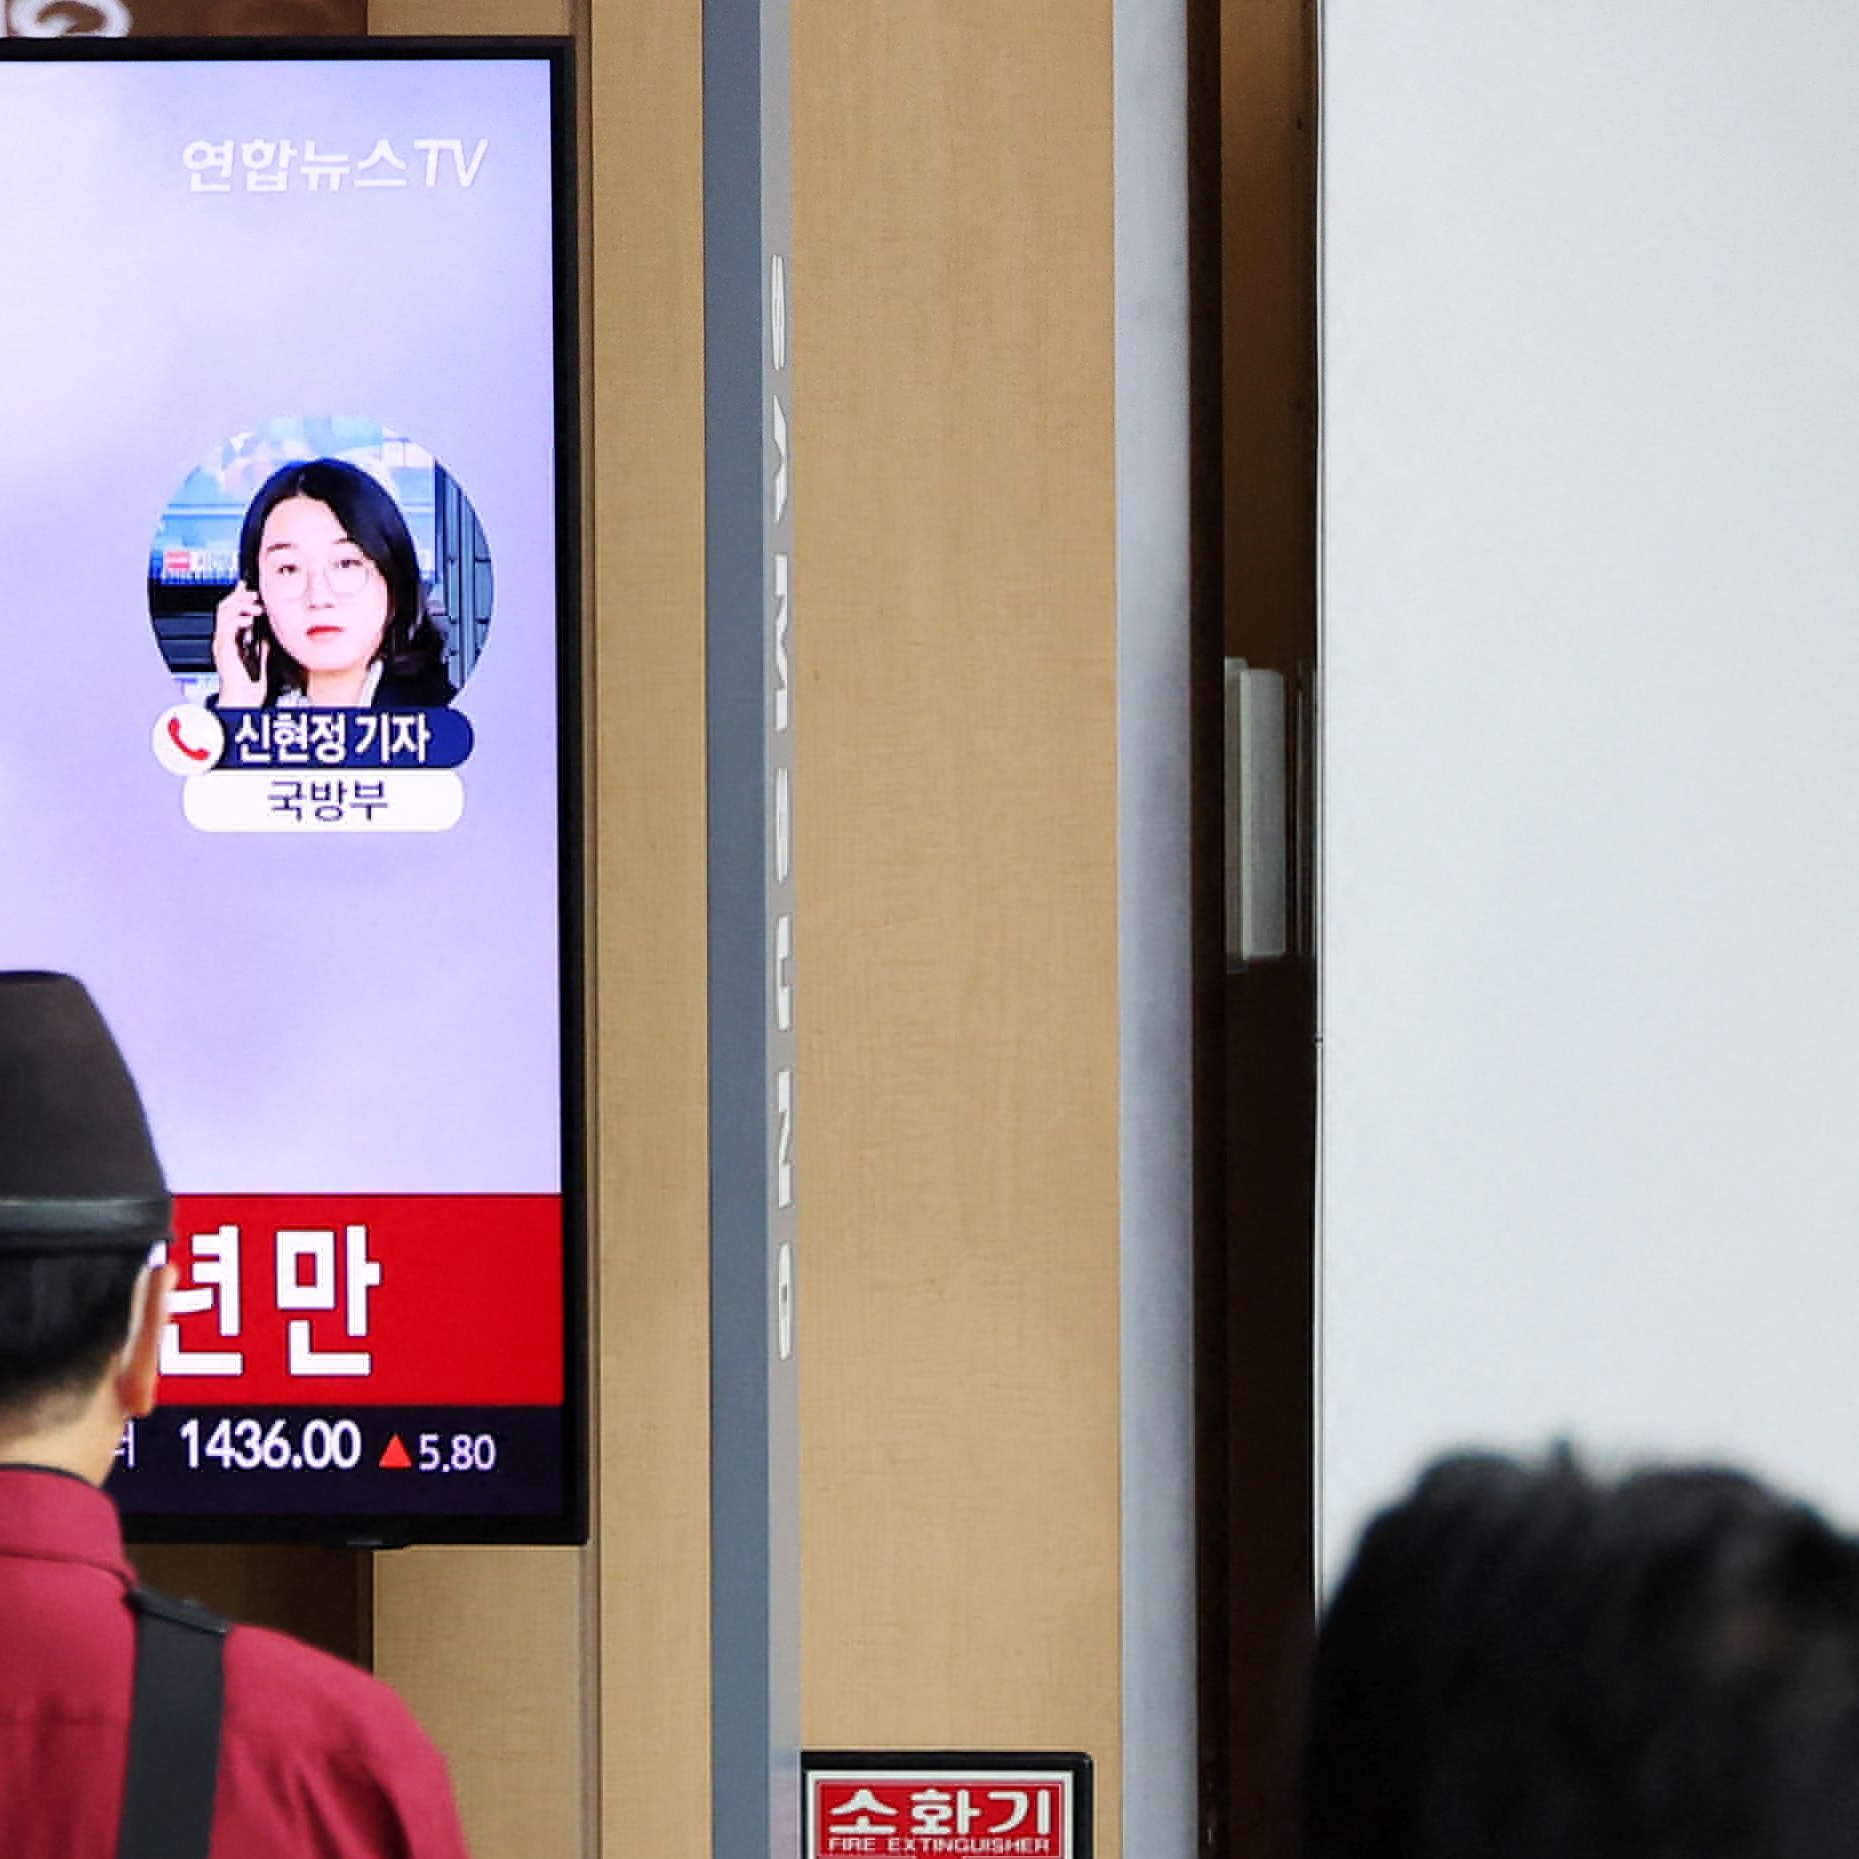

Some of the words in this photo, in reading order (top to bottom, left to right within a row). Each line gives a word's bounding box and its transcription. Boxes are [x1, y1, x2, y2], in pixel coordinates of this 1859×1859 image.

[183, 138, 489, 192] 연합뉴스TV
[234, 712, 347, 764] 신현정
[355, 712, 431, 764] 기자
[267, 779, 389, 823] 국방부
[276, 1223, 382, 1377] 만
[179, 1418, 362, 1469] 1436.00
[419, 1433, 497, 1473] 5.80
[828, 1788, 1052, 1835] 소화기
[828, 1837, 876, 1852] FIRE
